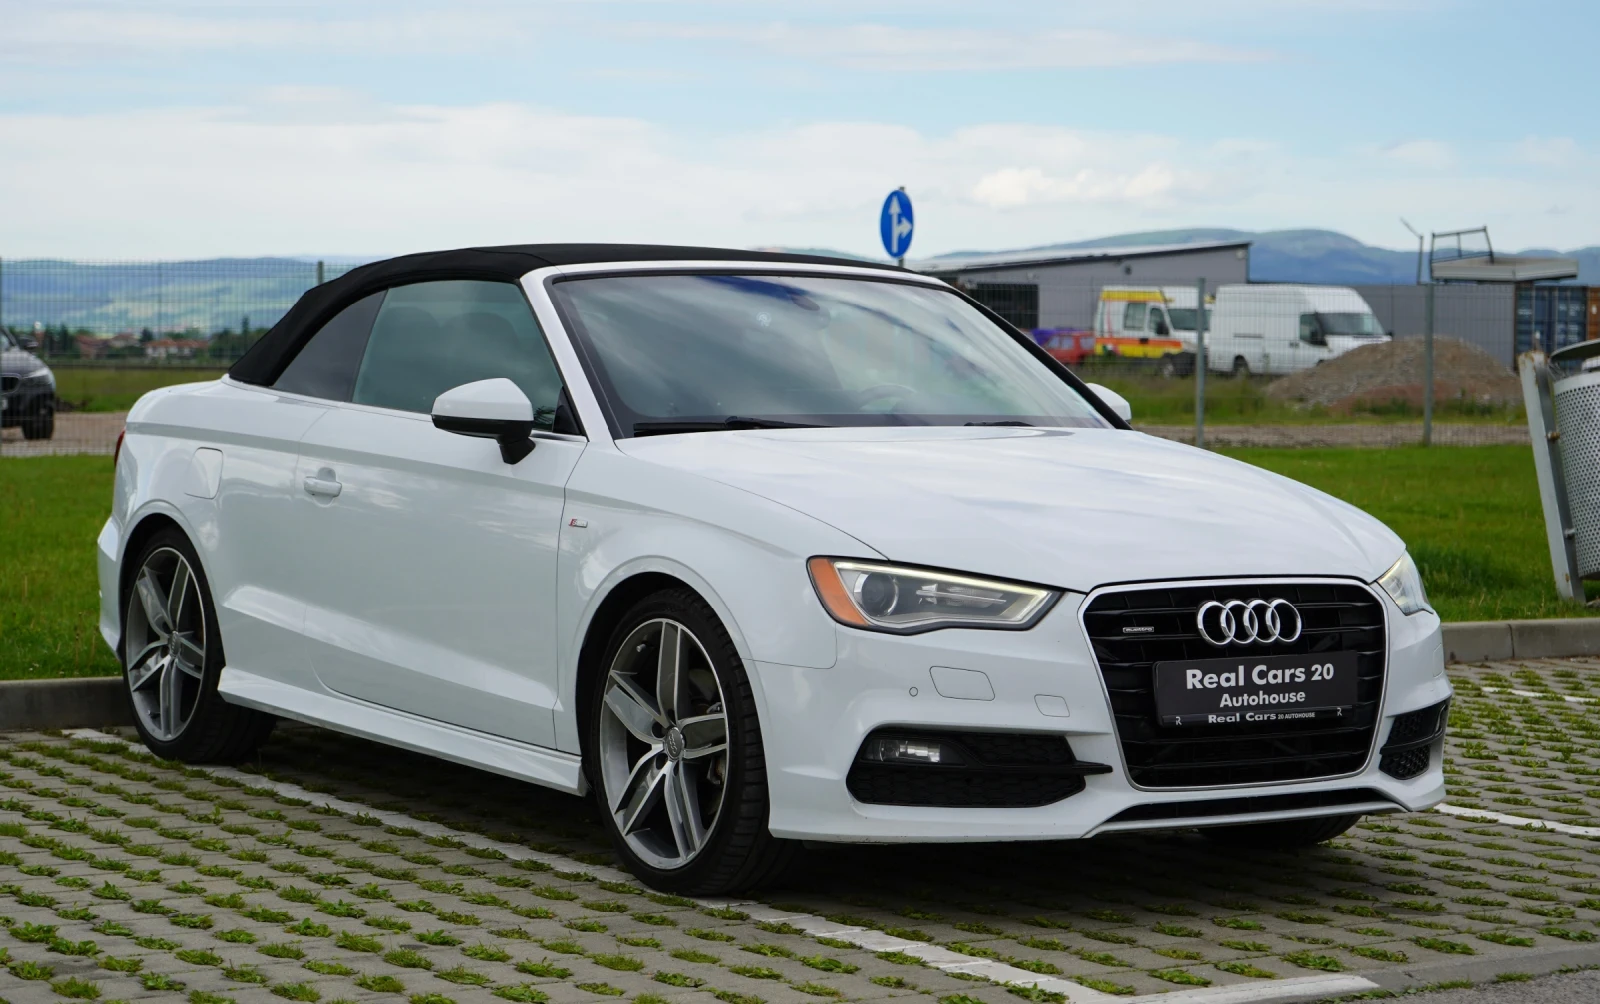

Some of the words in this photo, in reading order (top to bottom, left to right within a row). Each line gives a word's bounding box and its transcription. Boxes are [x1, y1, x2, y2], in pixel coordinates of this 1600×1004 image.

[1186, 665, 1245, 689] Real
[1252, 664, 1306, 685] Cars
[1311, 663, 1334, 681] 20
[1220, 691, 1306, 707] Autohouse
[1208, 713, 1240, 724] Real
[1246, 712, 1277, 721] Cars
